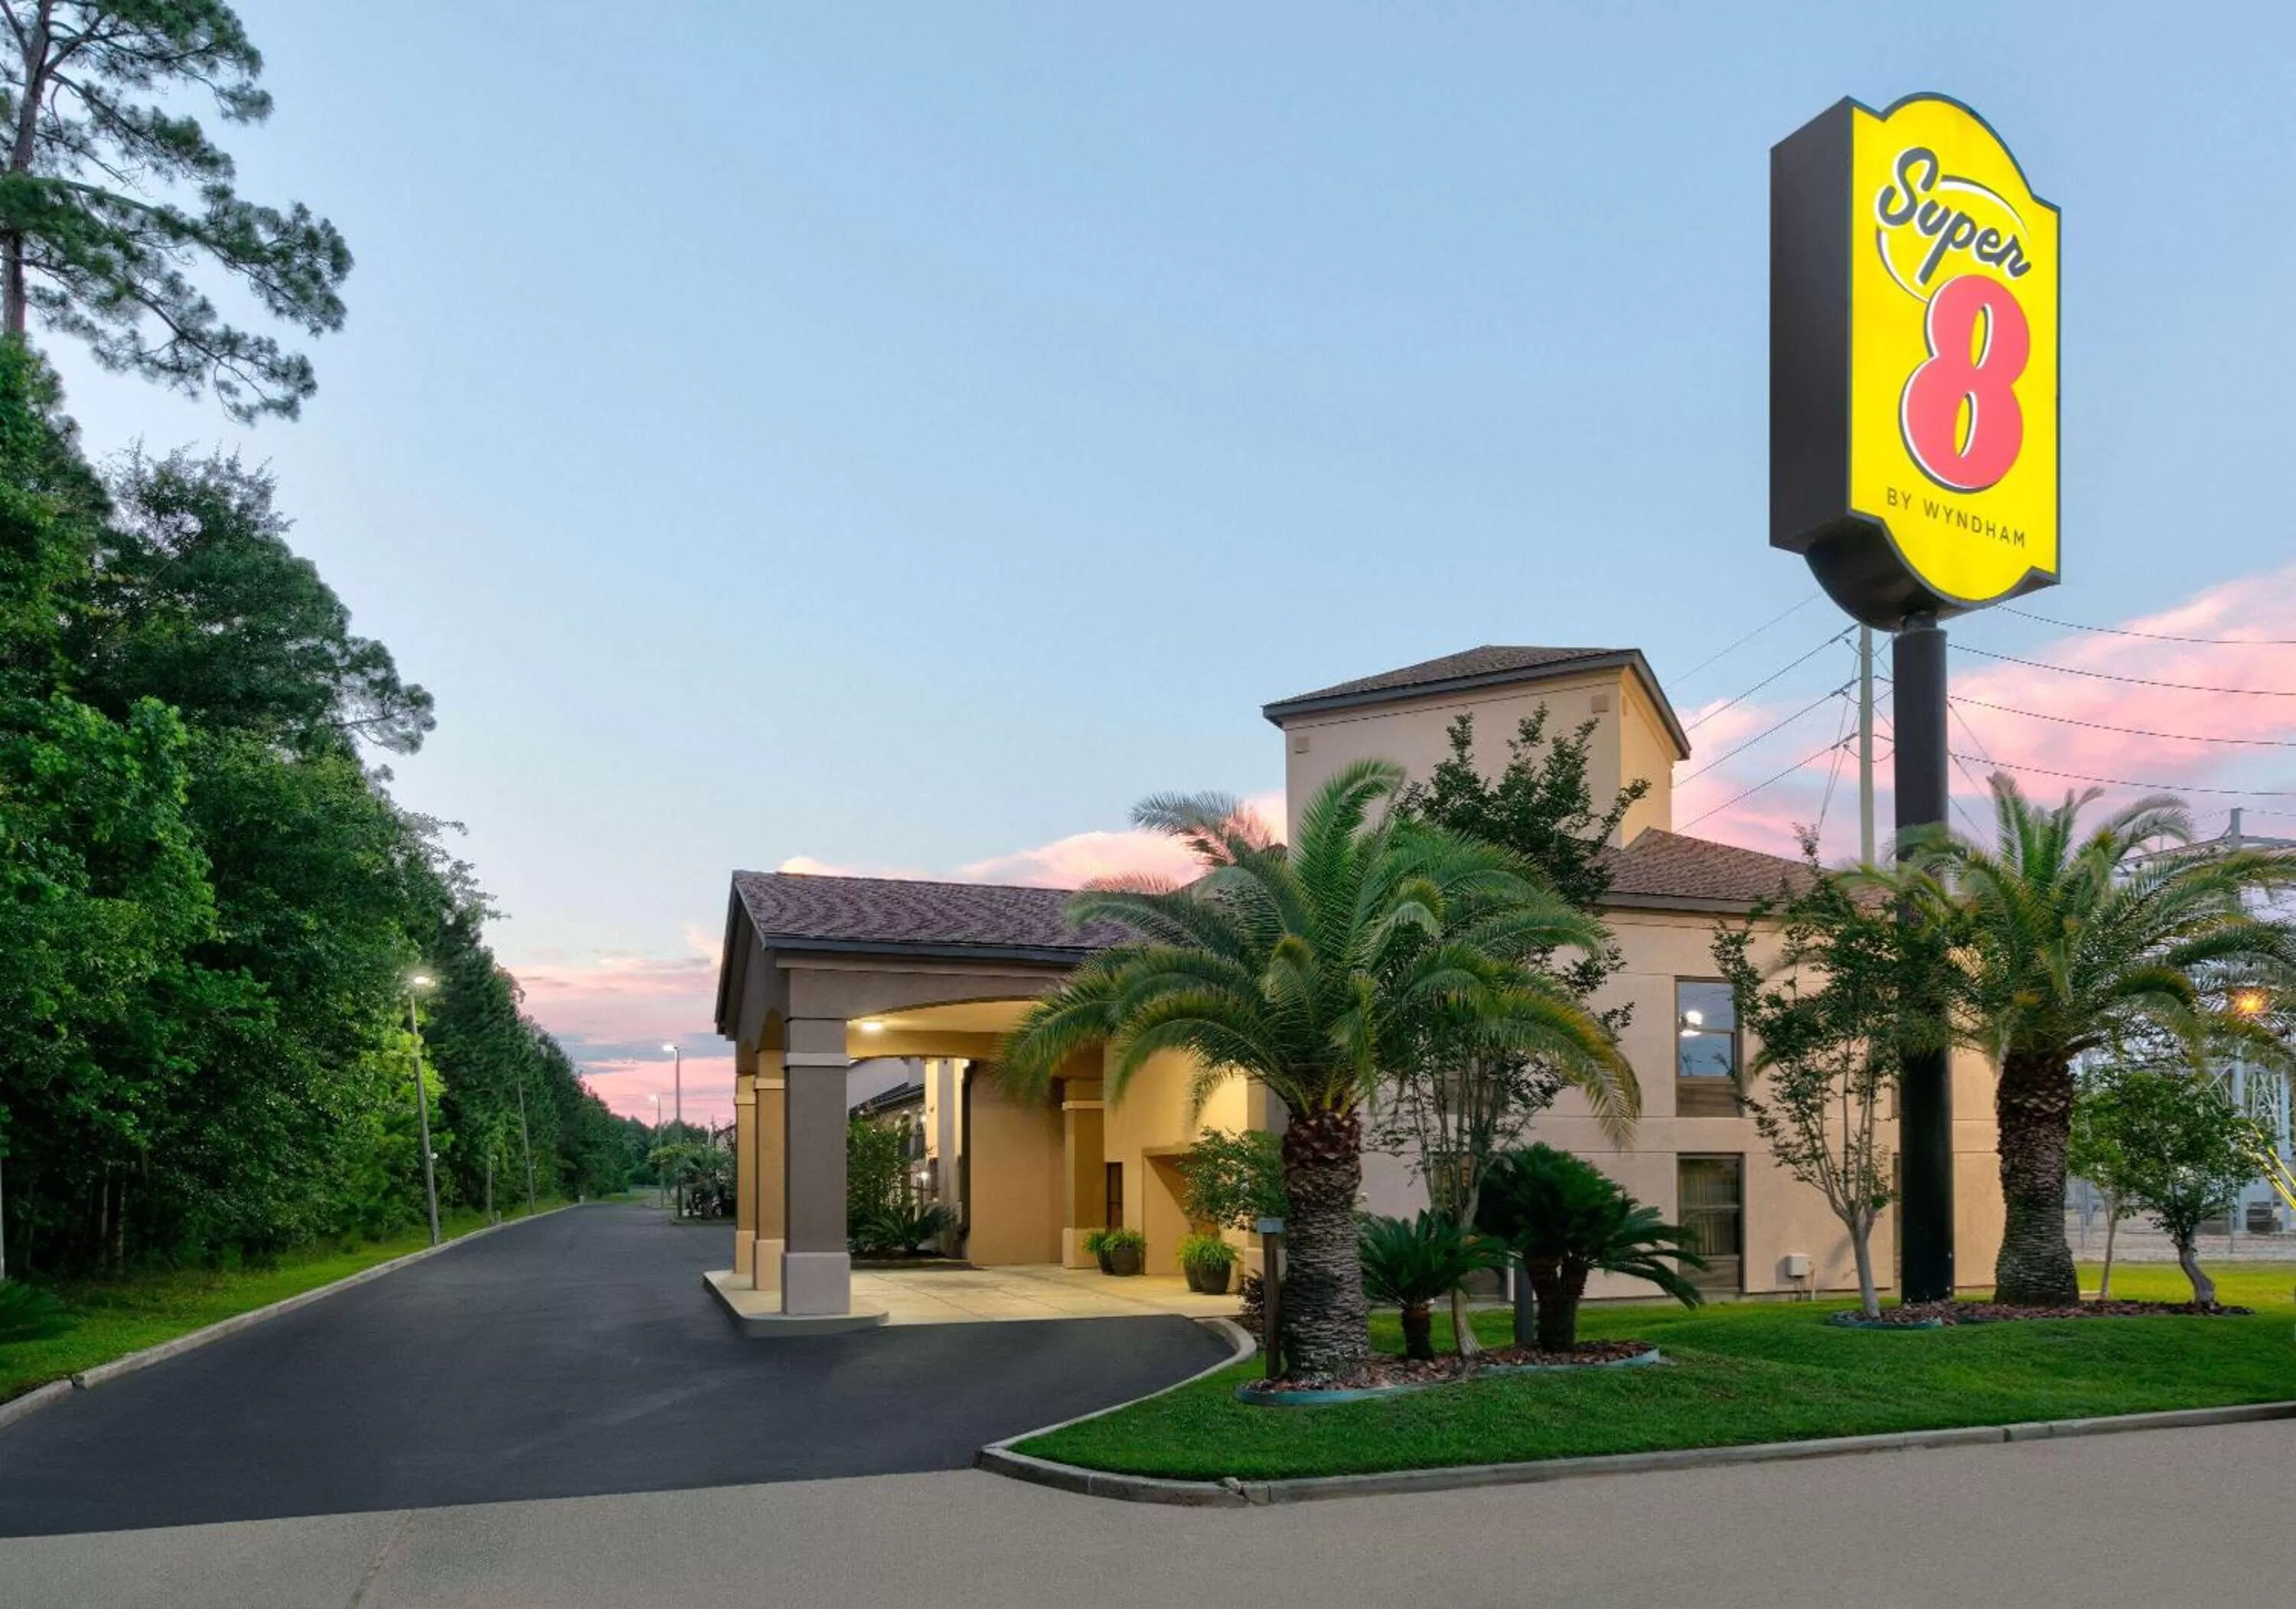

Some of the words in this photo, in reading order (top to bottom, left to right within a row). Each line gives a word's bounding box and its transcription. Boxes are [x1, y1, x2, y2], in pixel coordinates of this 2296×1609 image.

[1877, 147, 2032, 286] Super
[1899, 274, 2030, 494] 8
[1887, 488, 1912, 511] BY
[1923, 498, 2026, 549] WYNDHAM
